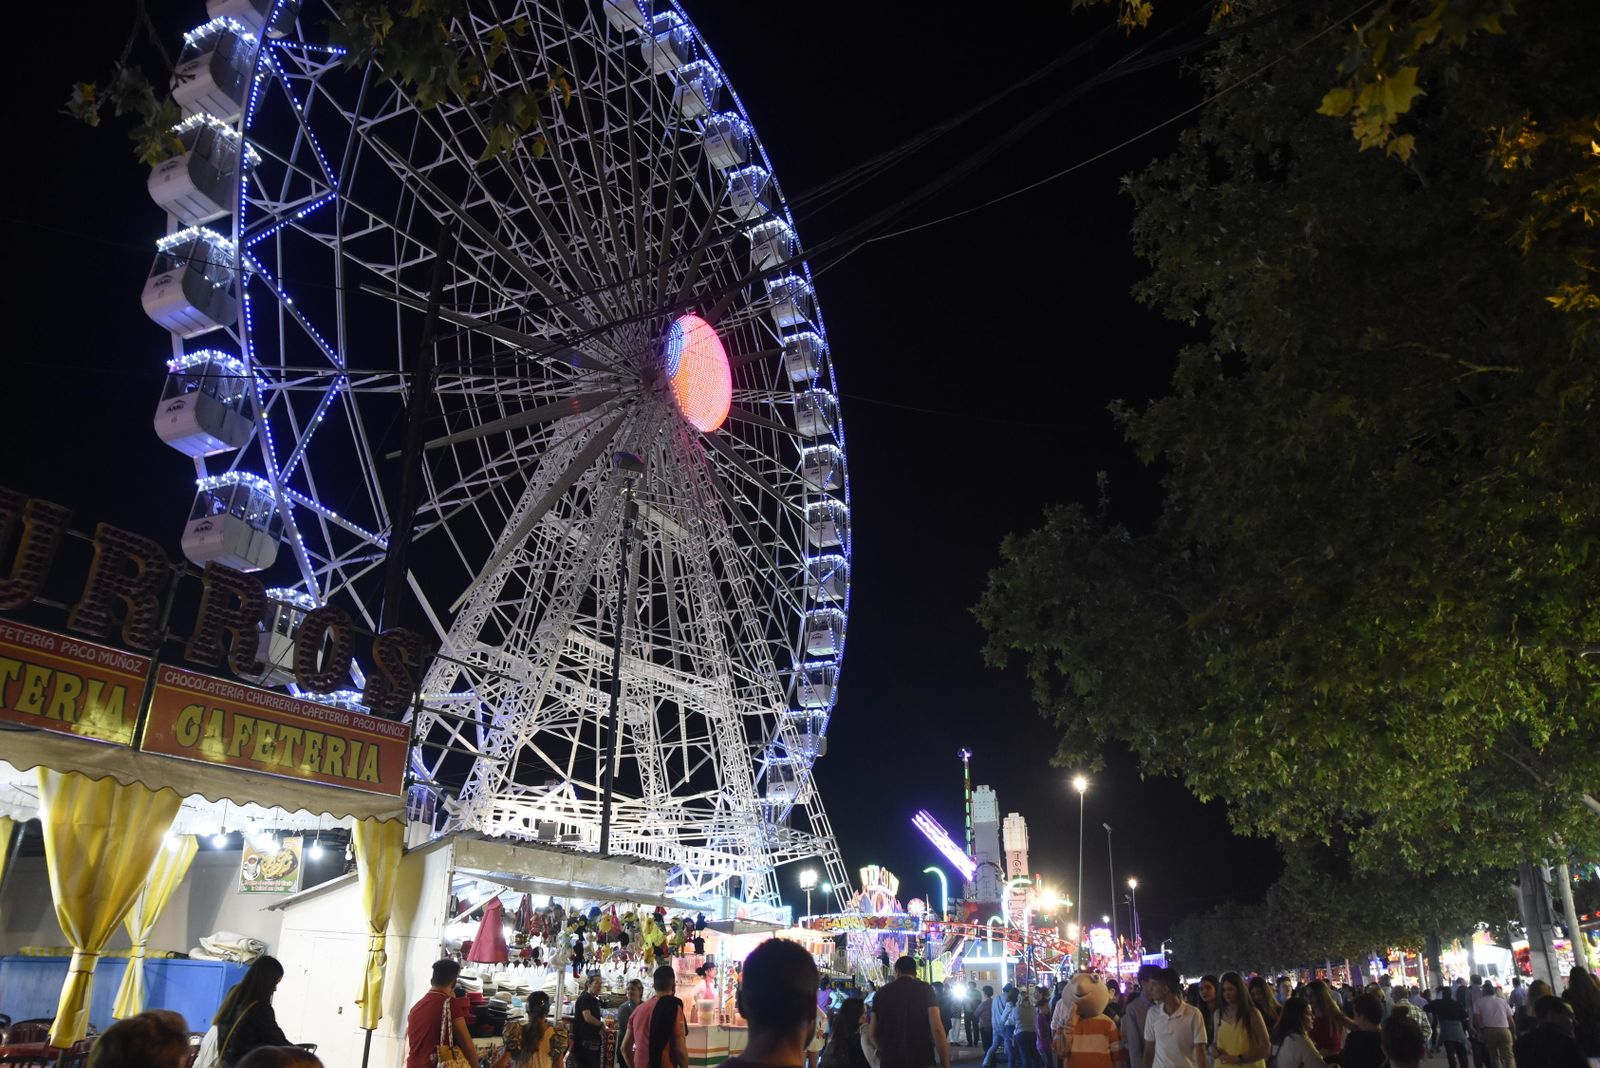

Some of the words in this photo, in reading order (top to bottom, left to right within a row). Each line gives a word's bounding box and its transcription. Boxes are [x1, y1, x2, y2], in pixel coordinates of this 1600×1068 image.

[60, 641, 96, 660] PACO
[98, 650, 143, 672] MUÑOZ
[164, 670, 244, 700] CHOCOLATERIA
[246, 691, 300, 714] CHURRERIA
[301, 705, 350, 726] CAFETERIA
[352, 716, 376, 732] PACO
[376, 722, 406, 738] MUÑOZ
[175, 703, 382, 784] CAFETERIA
